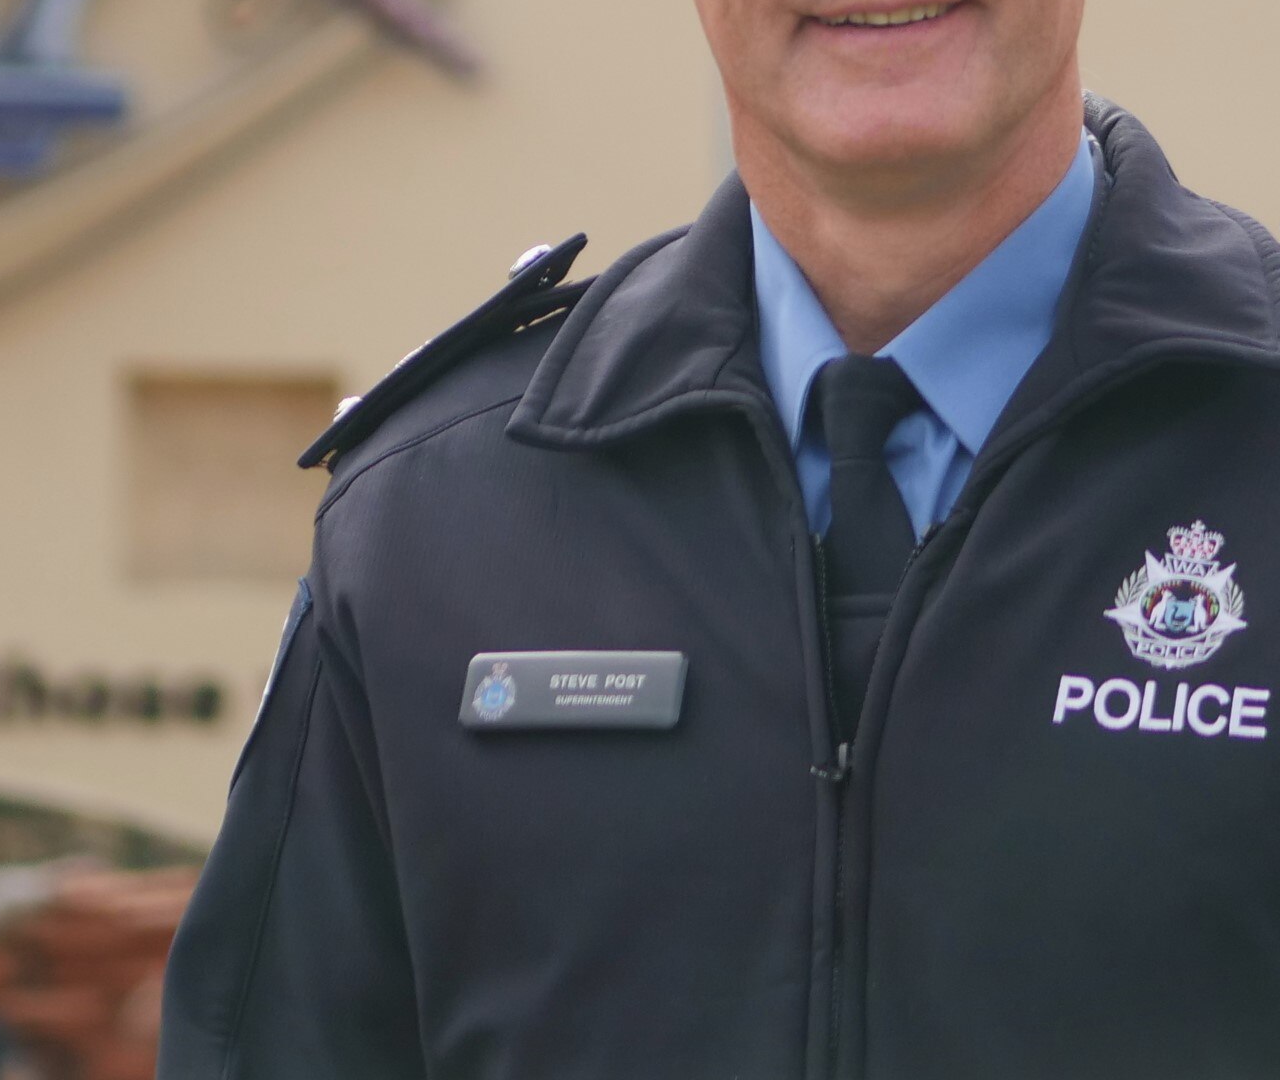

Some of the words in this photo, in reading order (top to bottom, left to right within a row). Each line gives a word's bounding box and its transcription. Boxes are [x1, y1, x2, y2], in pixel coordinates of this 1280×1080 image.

[1172, 558, 1206, 577] WA
[1136, 642, 1208, 659] POLICE
[549, 674, 598, 689] STEVE
[604, 674, 646, 689] POST
[555, 695, 634, 705] SUPERINTENDENT
[1052, 674, 1270, 739] POLICE
